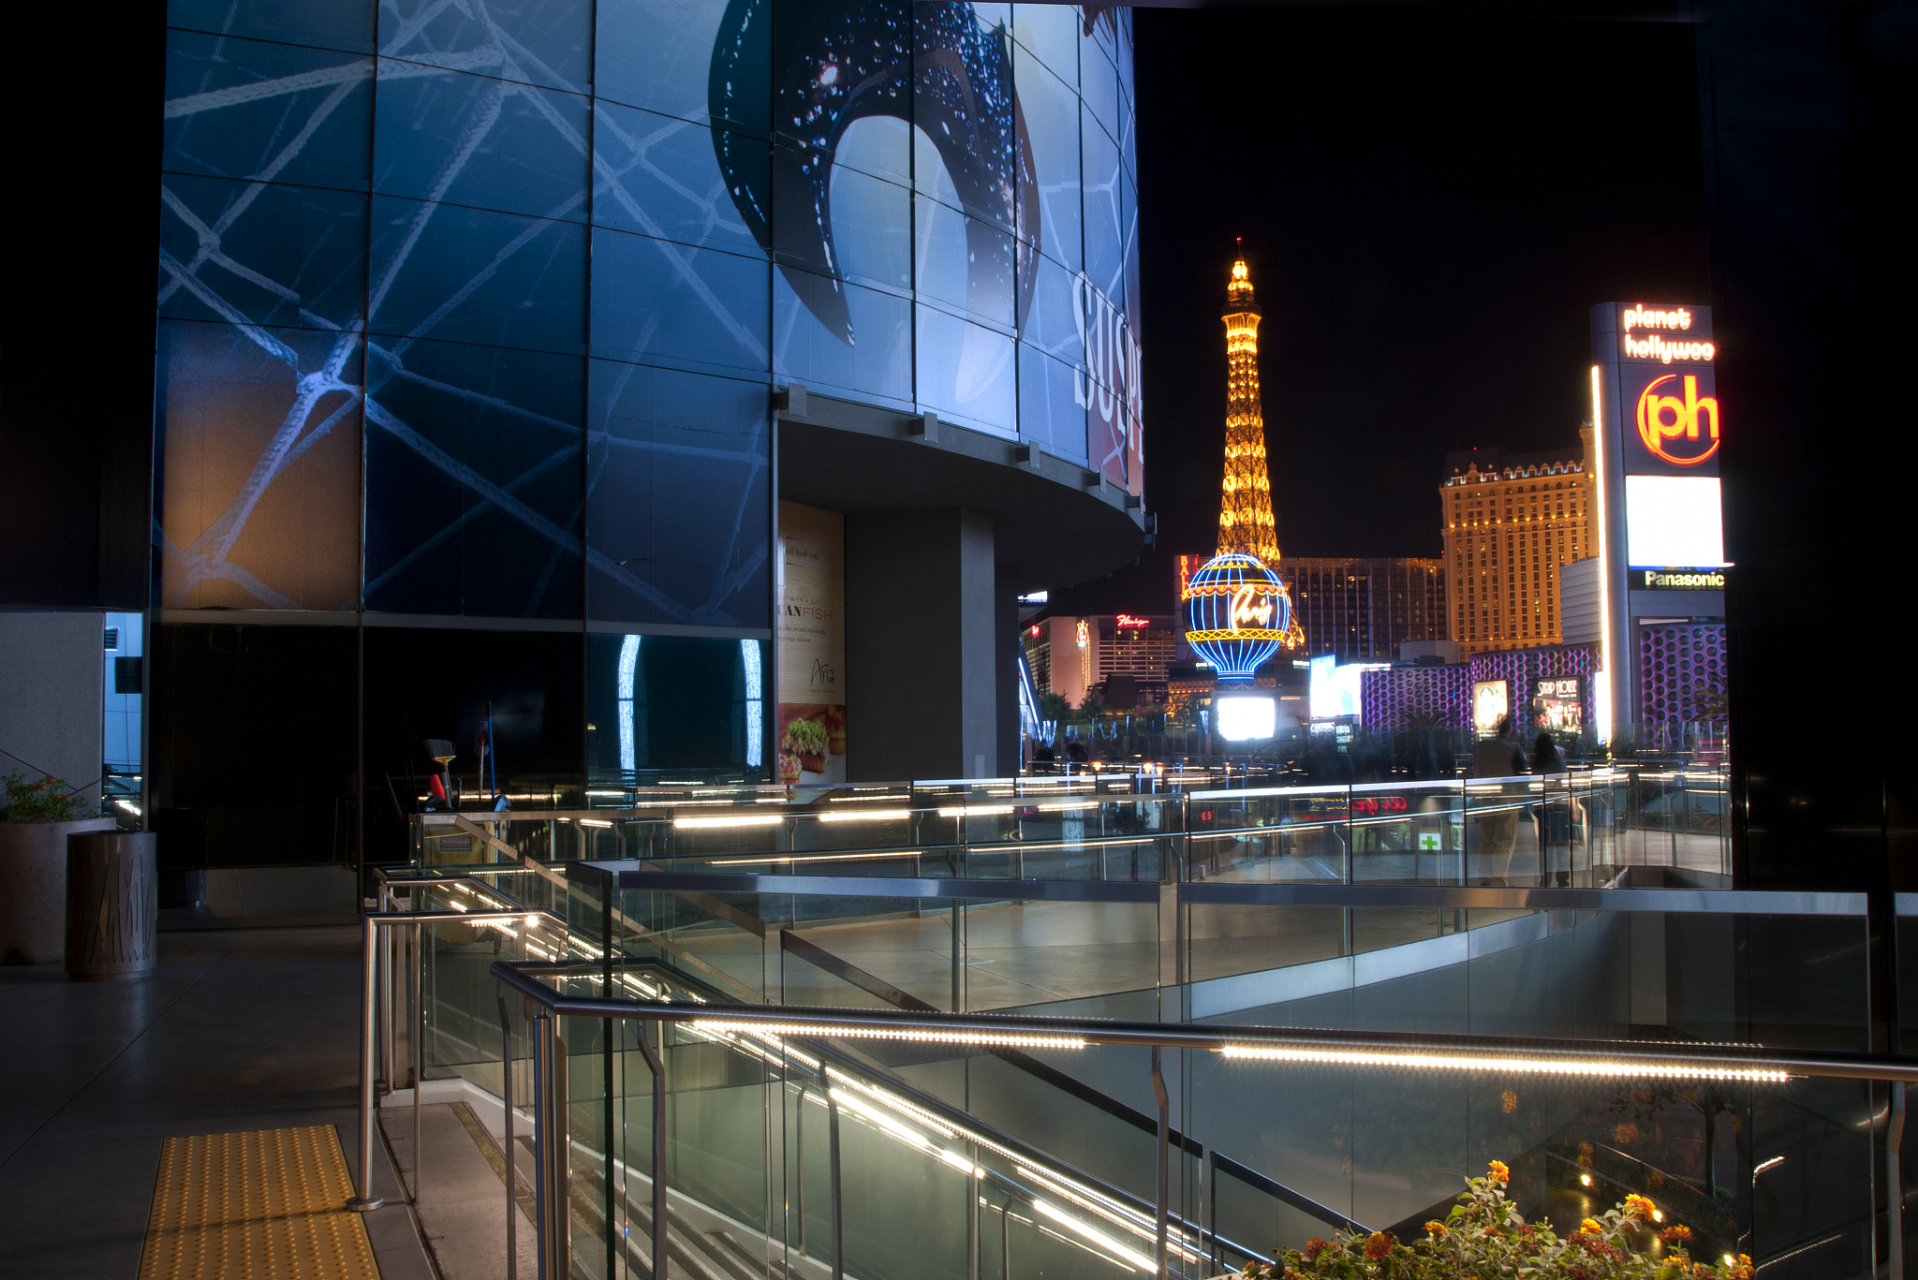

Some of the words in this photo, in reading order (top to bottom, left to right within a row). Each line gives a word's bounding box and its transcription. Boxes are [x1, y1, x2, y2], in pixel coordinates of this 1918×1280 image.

[1624, 304, 1691, 331] planet
[1646, 375, 1720, 451] ph
[1645, 570, 1725, 587] Panasonic
[1116, 614, 1150, 629] Flamingo
[1231, 584, 1273, 635] Paris
[810, 658, 835, 686] Aria
